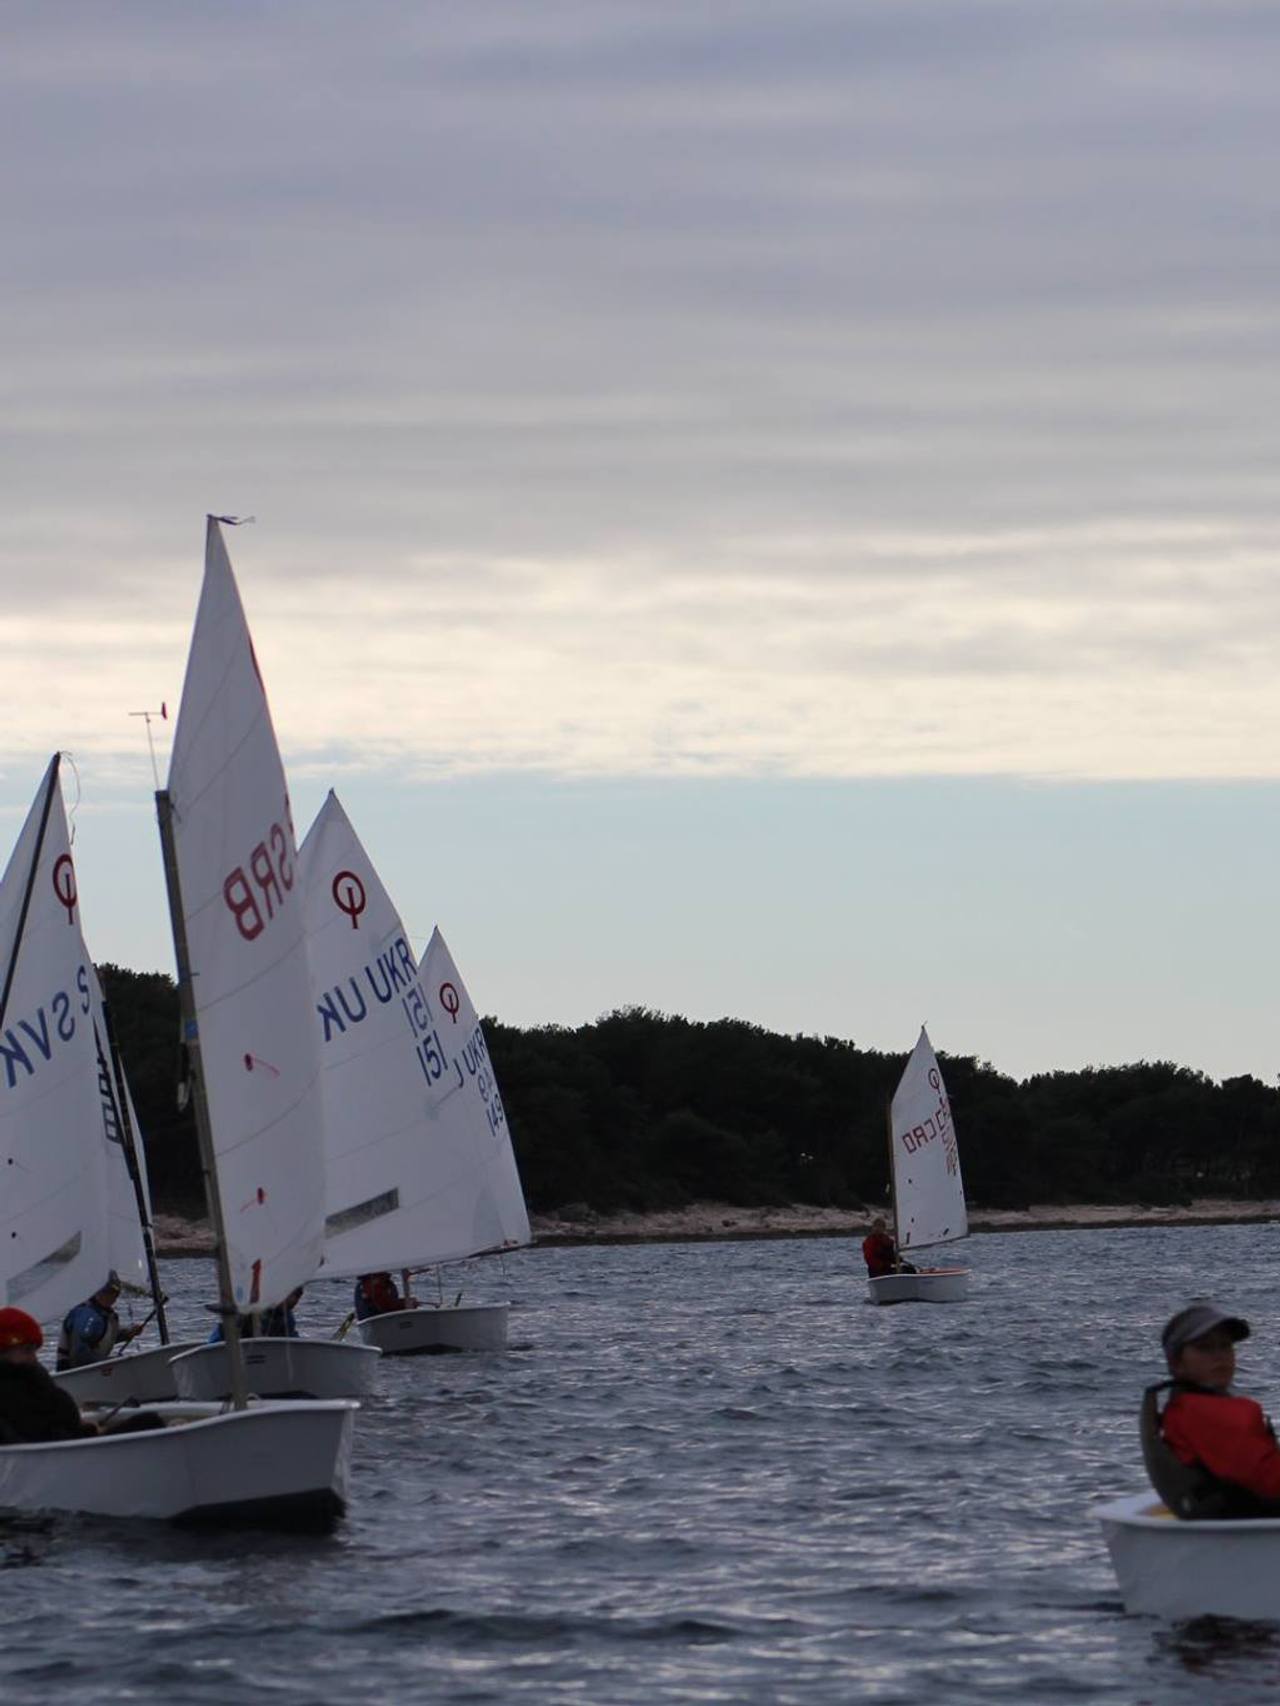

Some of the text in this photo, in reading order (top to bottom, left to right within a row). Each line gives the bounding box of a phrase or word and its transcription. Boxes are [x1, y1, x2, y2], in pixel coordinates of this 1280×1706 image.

[369, 937, 418, 1005] UKR
[417, 1030, 448, 1087] 151
[461, 1026, 487, 1075] UKR
